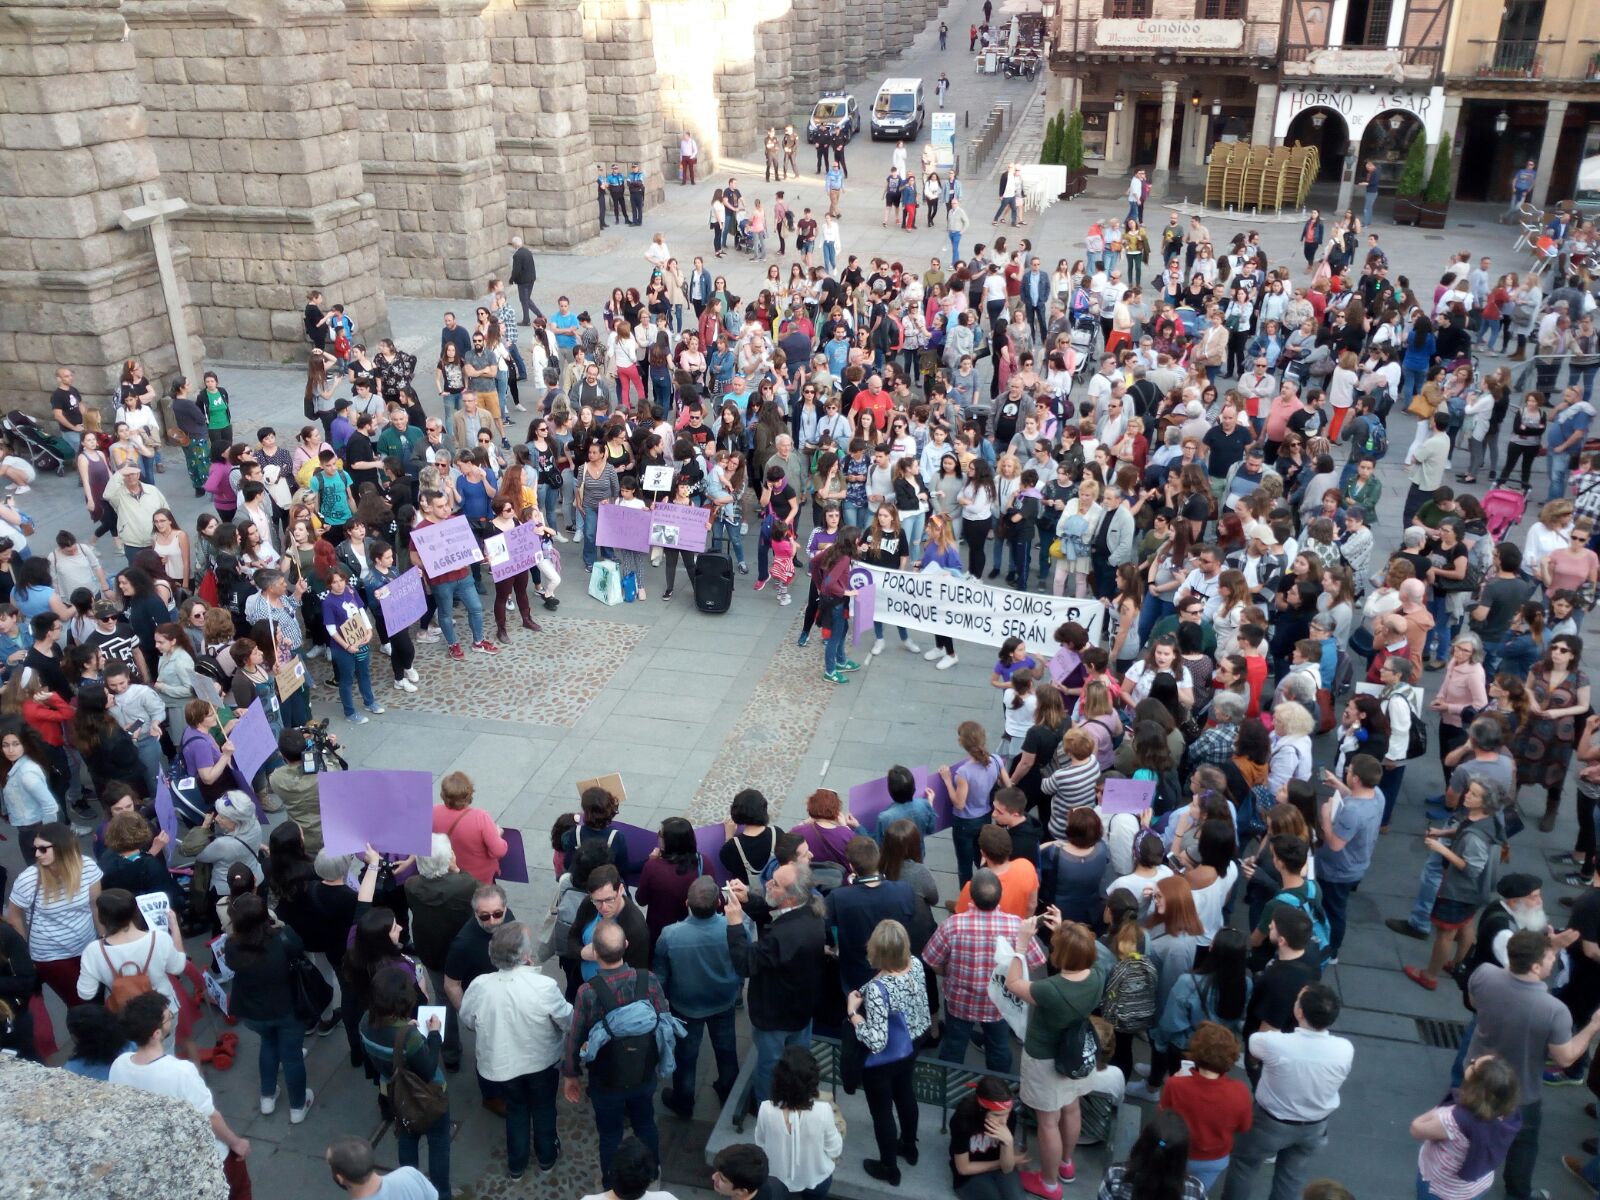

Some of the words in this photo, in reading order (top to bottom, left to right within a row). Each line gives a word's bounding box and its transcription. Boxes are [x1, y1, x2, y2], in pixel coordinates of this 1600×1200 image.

[1289, 92, 1353, 118] HORNO
[1351, 114, 1363, 125] DE
[1376, 95, 1431, 124] ASAR
[882, 571, 933, 598] PORQUE
[1003, 594, 1057, 621] SOMOS,
[344, 618, 358, 636] NO
[887, 598, 938, 623] PORQUE
[945, 610, 995, 637] SOMOS,
